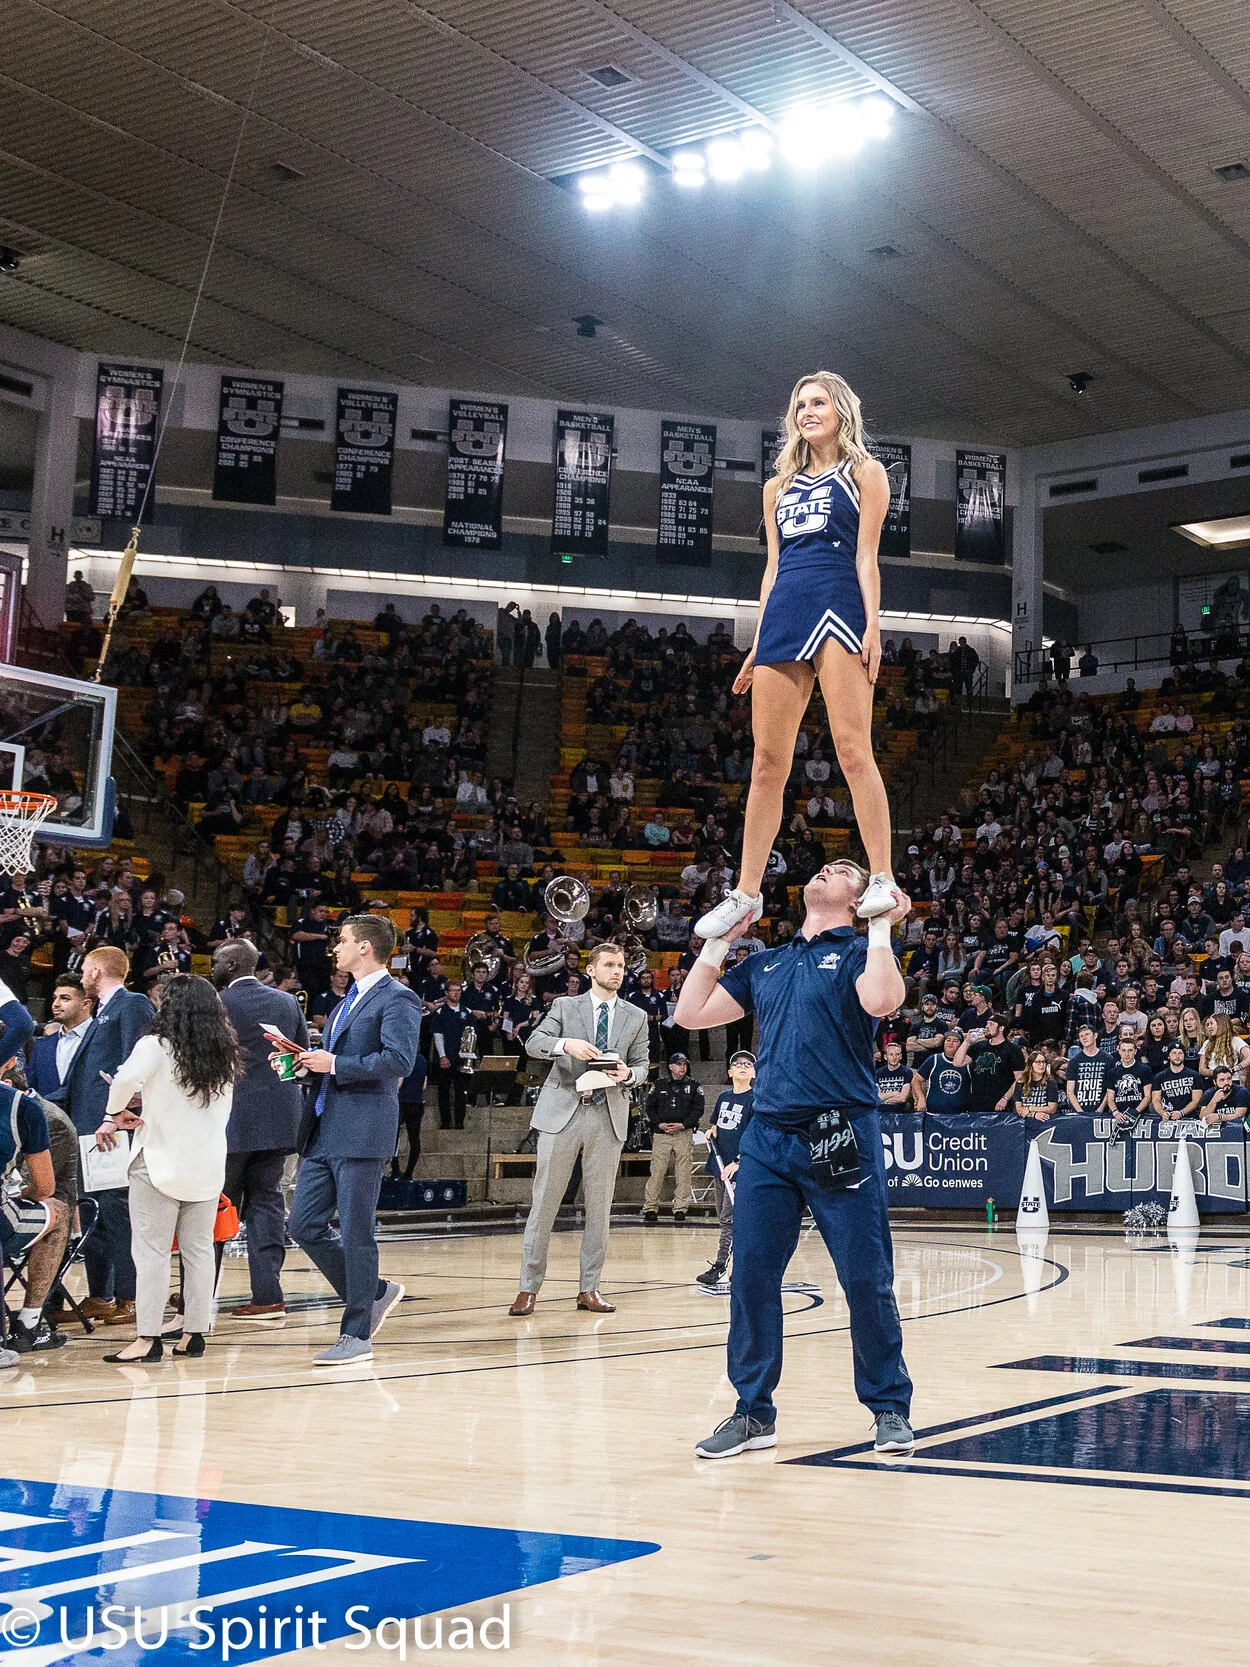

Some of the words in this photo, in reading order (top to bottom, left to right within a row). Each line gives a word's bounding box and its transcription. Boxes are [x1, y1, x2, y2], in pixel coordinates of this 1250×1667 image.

[340, 399, 394, 410] VOLLEYBALL
[452, 410, 504, 420] VOLLEYBALL
[573, 415, 598, 424] MEN'S
[560, 420, 612, 432] BASKETBALL
[676, 426, 701, 434] MEN'S
[220, 436, 276, 448] CONFERENCE
[663, 431, 714, 442] BASKETBALL
[337, 447, 392, 458] CONFERENCE
[338, 454, 390, 464] CHAMPIONS
[958, 460, 1004, 470] BASKETBALL
[559, 474, 607, 484] CHAMPIONS
[676, 478, 698, 486] NCAA
[661, 483, 712, 494] APPEARANCES
[776, 498, 832, 526] STATE
[451, 521, 494, 532] NATIONAL
[51, 526, 64, 542] H
[448, 528, 497, 538] CHAMPIONS
[1016, 602, 1026, 616] H
[1042, 1006, 1058, 1014] PUMA
[1078, 1080, 1102, 1090] TRUE
[1161, 1076, 1194, 1092] AGGIES
[1077, 1090, 1102, 1102] BLUE
[1093, 1118, 1154, 1139] UH
[928, 1132, 988, 1151] Credit
[928, 1152, 988, 1172] Union
[887, 1176, 898, 1188] of
